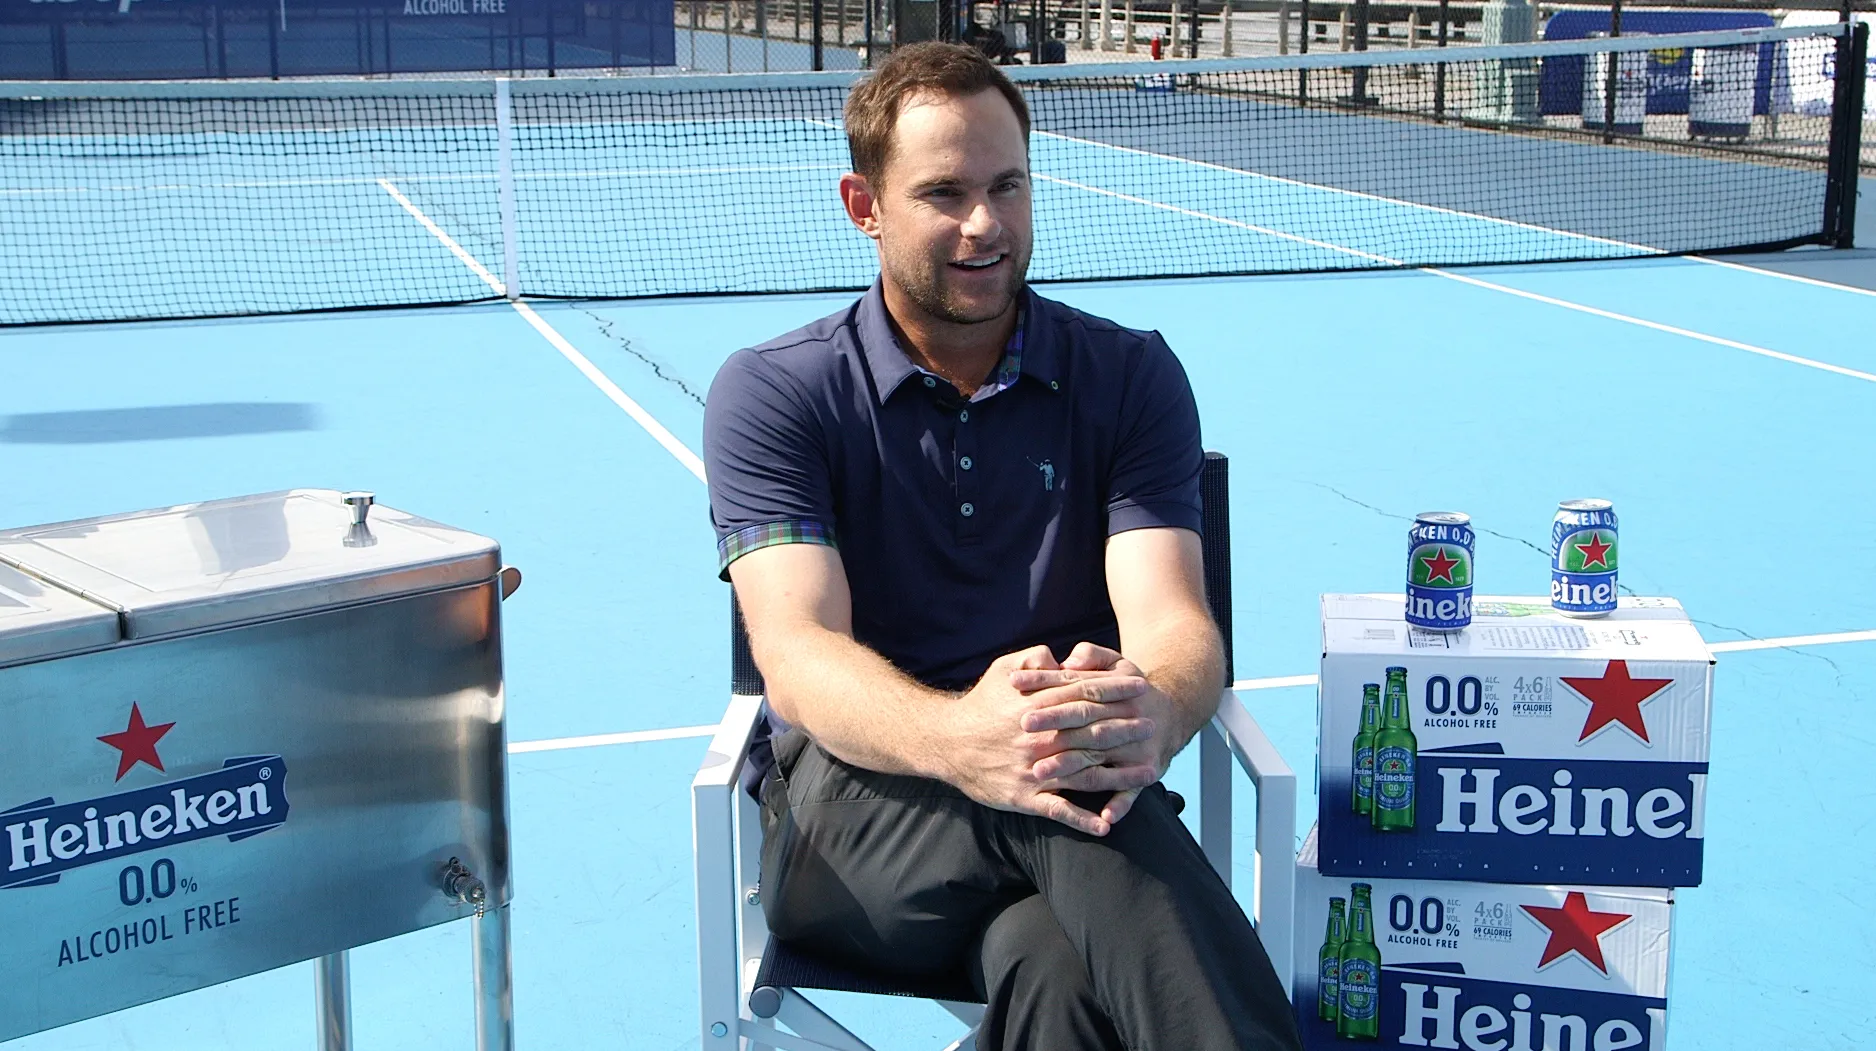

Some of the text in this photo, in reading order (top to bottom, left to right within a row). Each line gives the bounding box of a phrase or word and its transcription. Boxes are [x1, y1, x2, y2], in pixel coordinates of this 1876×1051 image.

[403, 0, 506, 15] ALCOHOL FREE
[1485, 676, 1500, 684] ALC.
[1513, 676, 1543, 693] 4x6
[1485, 684, 1494, 692] BY
[1485, 692, 1500, 701] VOL.
[1513, 693, 1543, 702] PACK
[1522, 704, 1552, 712] CALORIES
[1424, 718, 1497, 729] ALCOHOL FREE
[1474, 901, 1504, 920] 4x6
[57, 896, 241, 968] ALCOHOL FREE
[1483, 928, 1512, 937] CALORIES
[1387, 934, 1458, 949] ALCOHOL FREE
